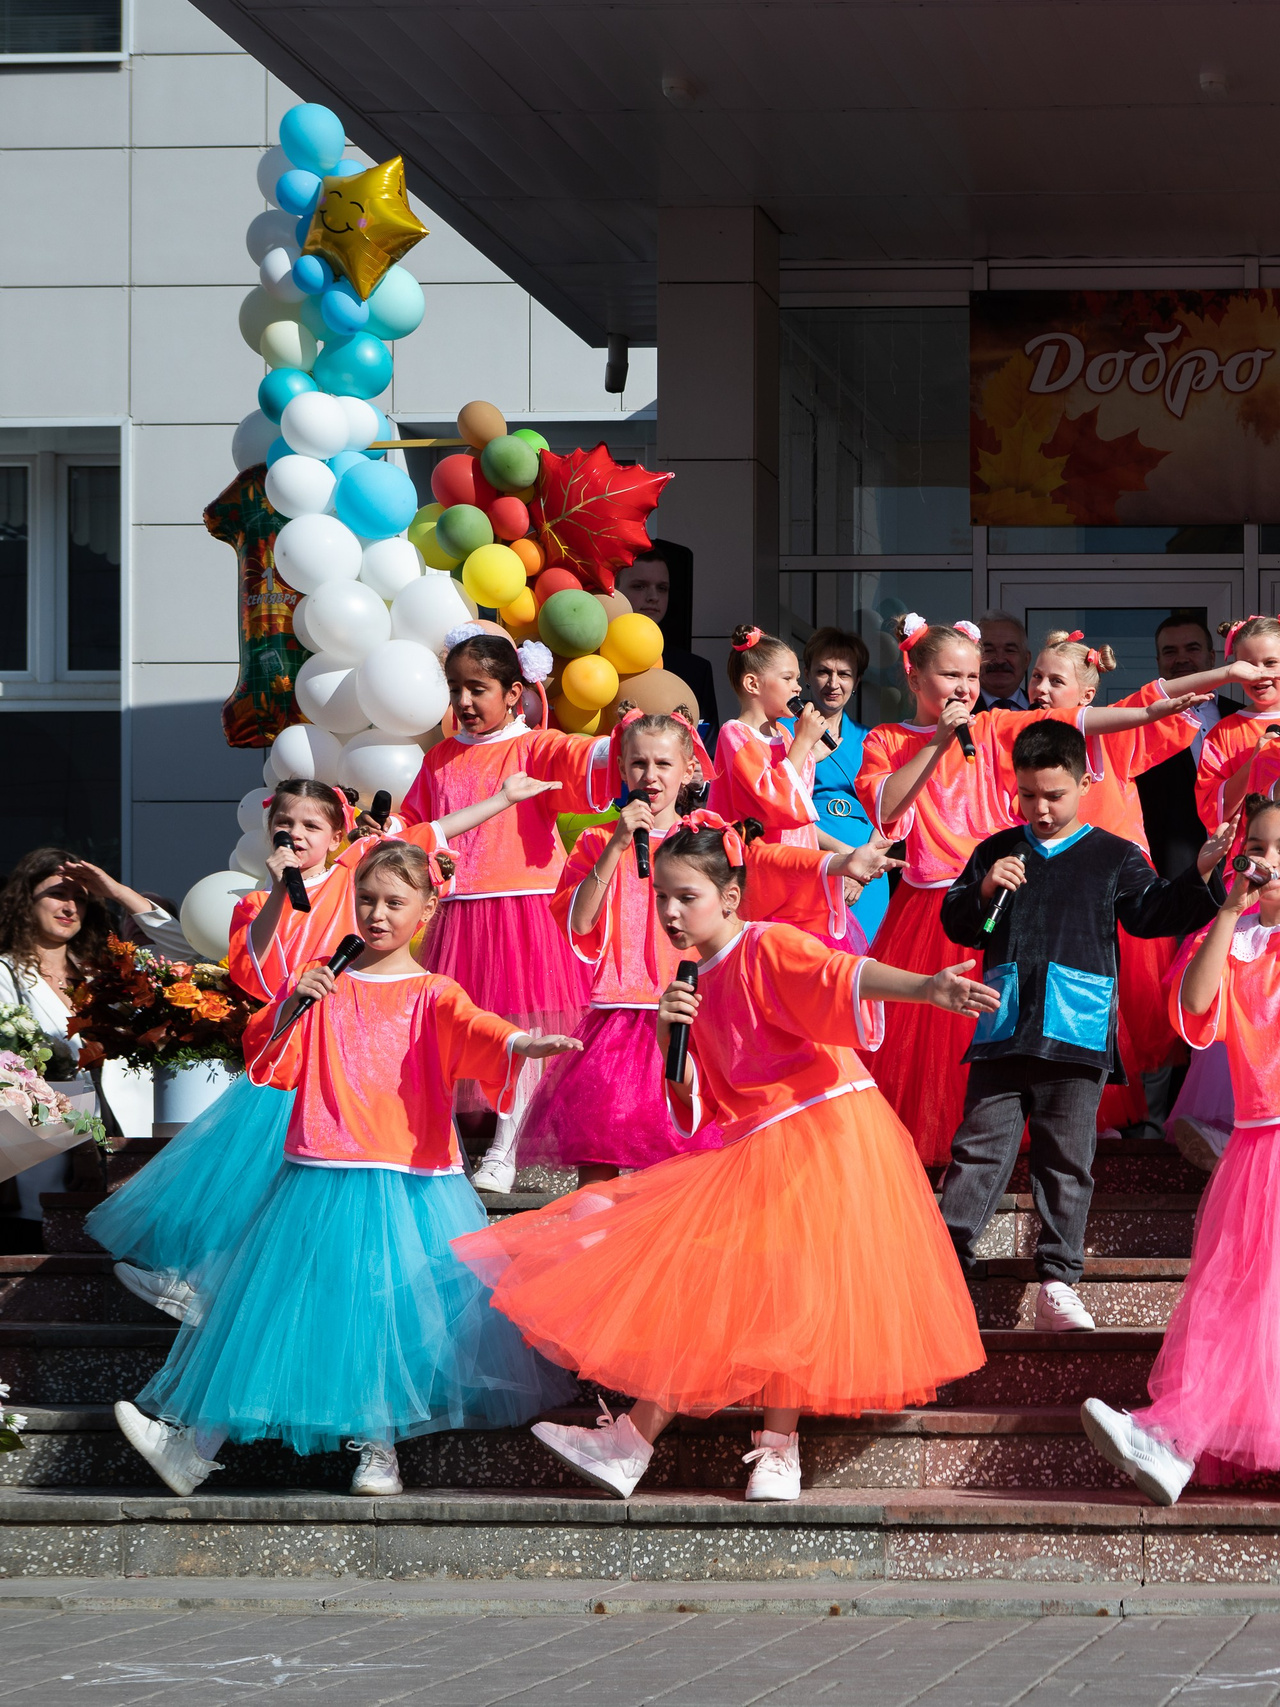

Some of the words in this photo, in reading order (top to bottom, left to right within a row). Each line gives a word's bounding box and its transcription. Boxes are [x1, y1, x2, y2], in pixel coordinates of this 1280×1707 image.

[1024, 323, 1275, 419] Добро
[261, 566, 274, 592] 1
[247, 592, 297, 606] СЕНТЯБРЯ
